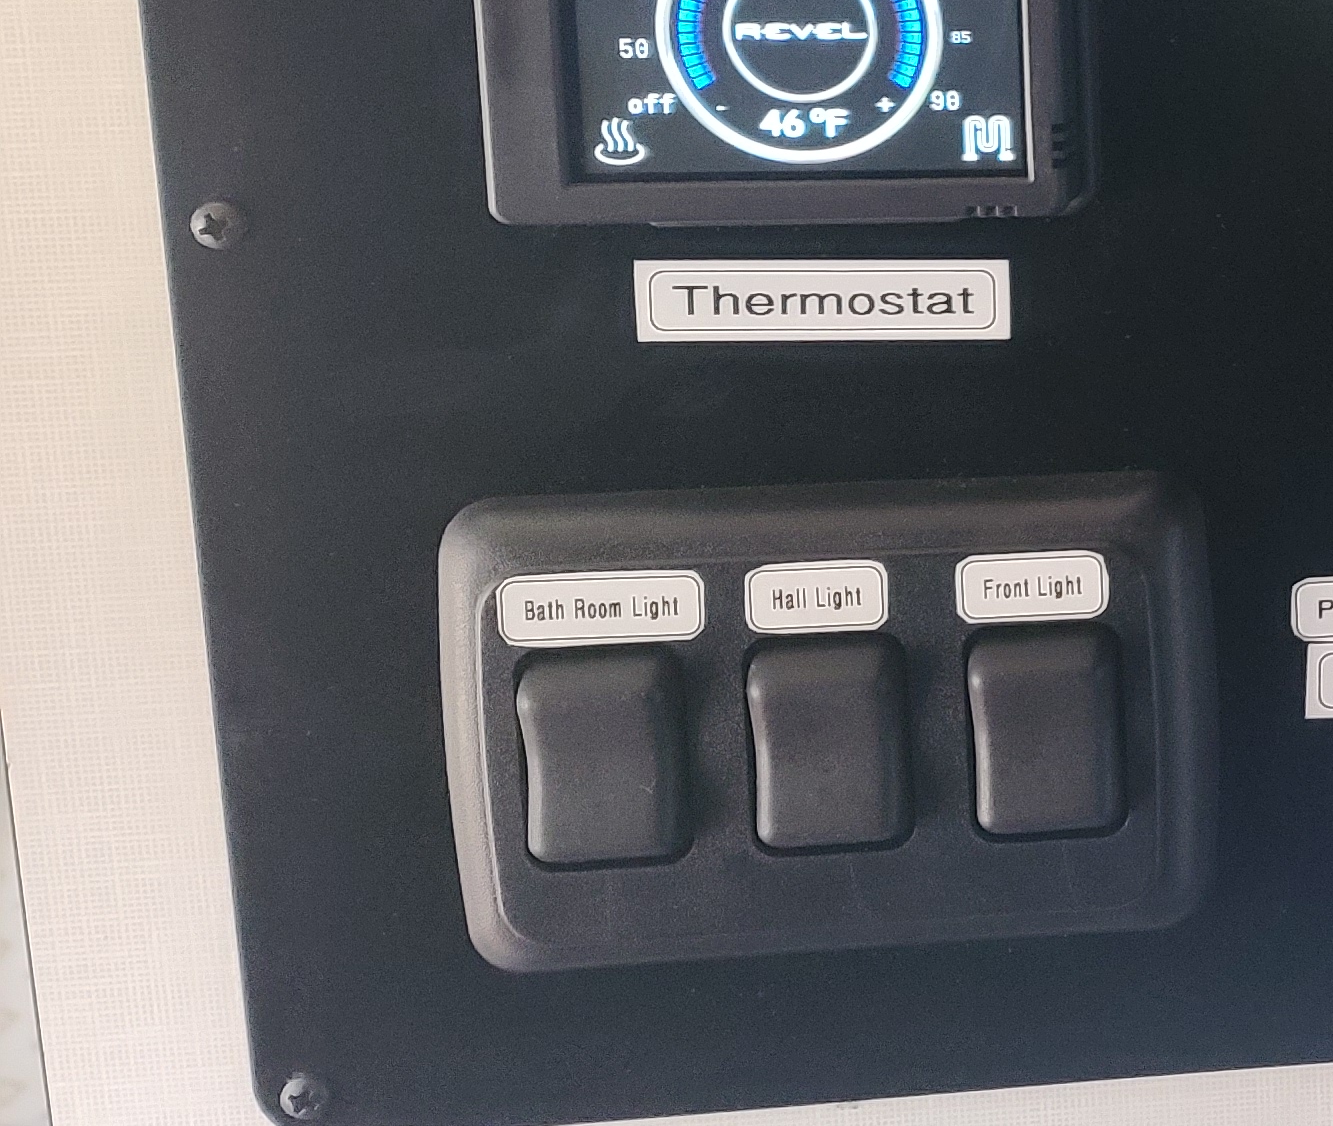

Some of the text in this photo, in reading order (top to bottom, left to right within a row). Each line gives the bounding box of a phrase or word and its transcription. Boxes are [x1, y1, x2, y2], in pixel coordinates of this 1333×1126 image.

[735, 22, 868, 40] REVEL
[951, 30, 971, 44] 85
[618, 38, 650, 59] 50
[628, 92, 676, 115] off
[929, 90, 960, 111] 90
[673, 285, 976, 317] Thermostat
[771, 585, 862, 612] Hall Light
[983, 574, 1083, 602] Front Light
[524, 595, 679, 622] Bath Room Light
